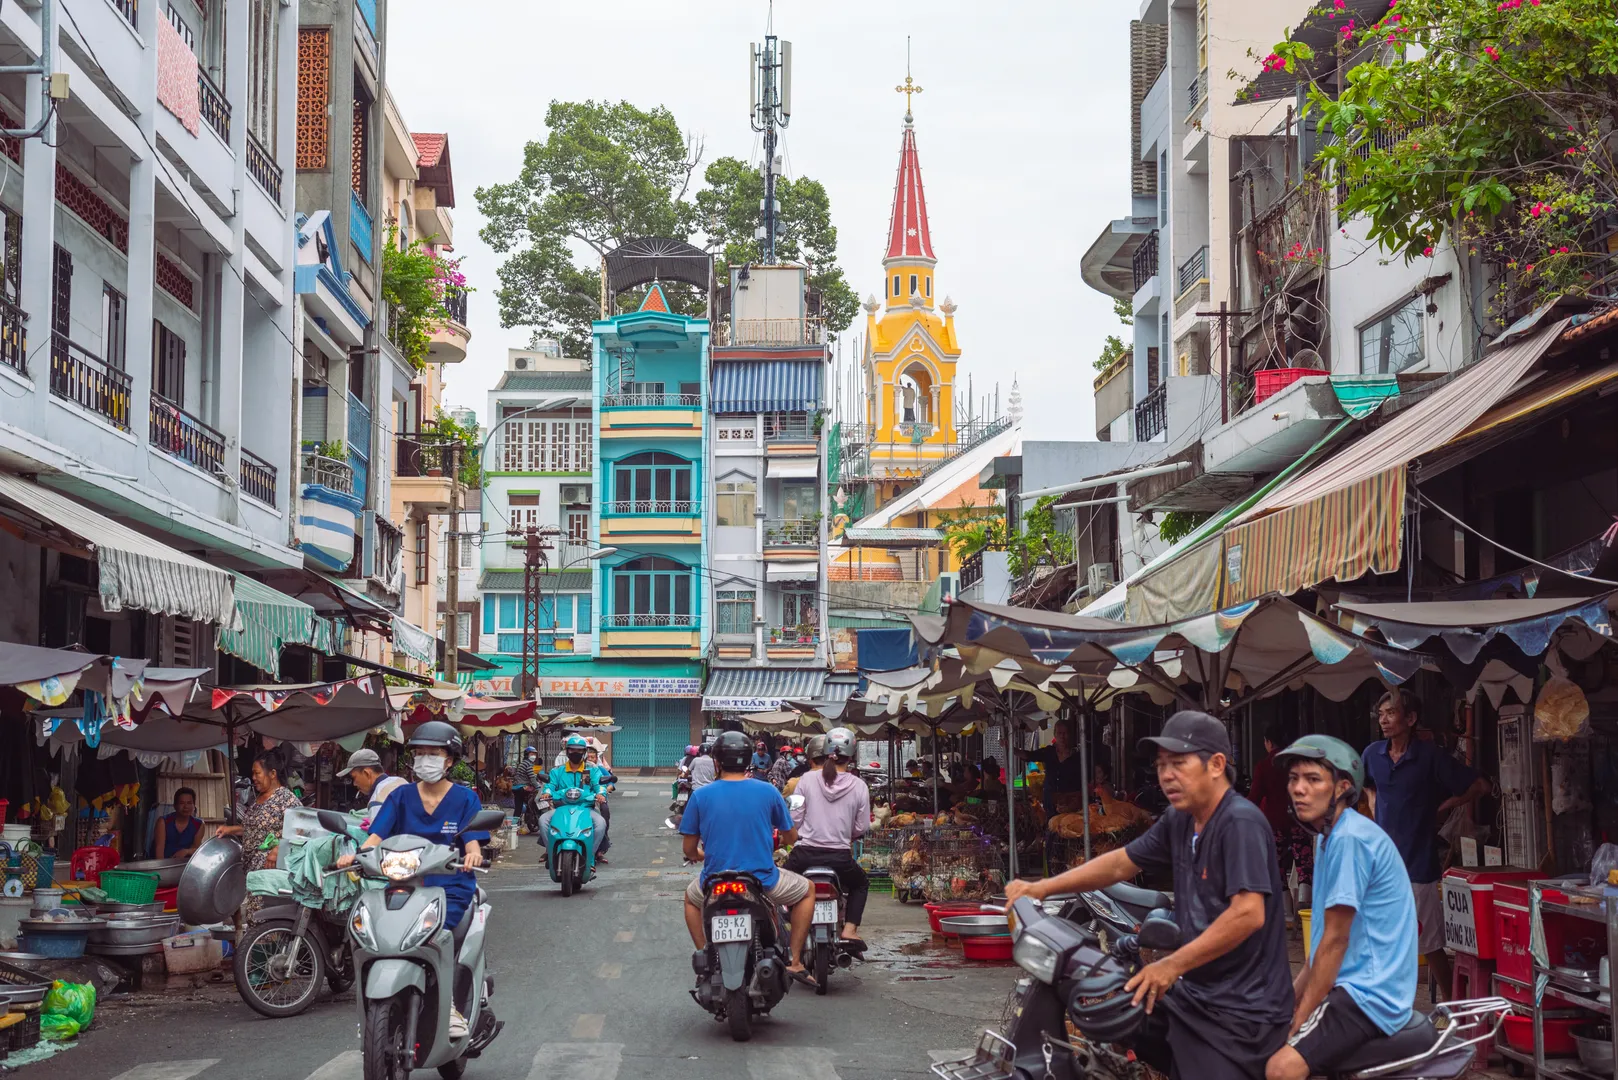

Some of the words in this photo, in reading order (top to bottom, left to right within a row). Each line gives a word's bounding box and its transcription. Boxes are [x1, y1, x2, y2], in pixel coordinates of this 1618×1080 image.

[551, 678, 609, 692] PHÁT
[732, 698, 766, 706] TUẤN
[1447, 890, 1469, 914] CUA
[718, 918, 746, 928] 59-K2
[714, 928, 748, 940] 061.44
